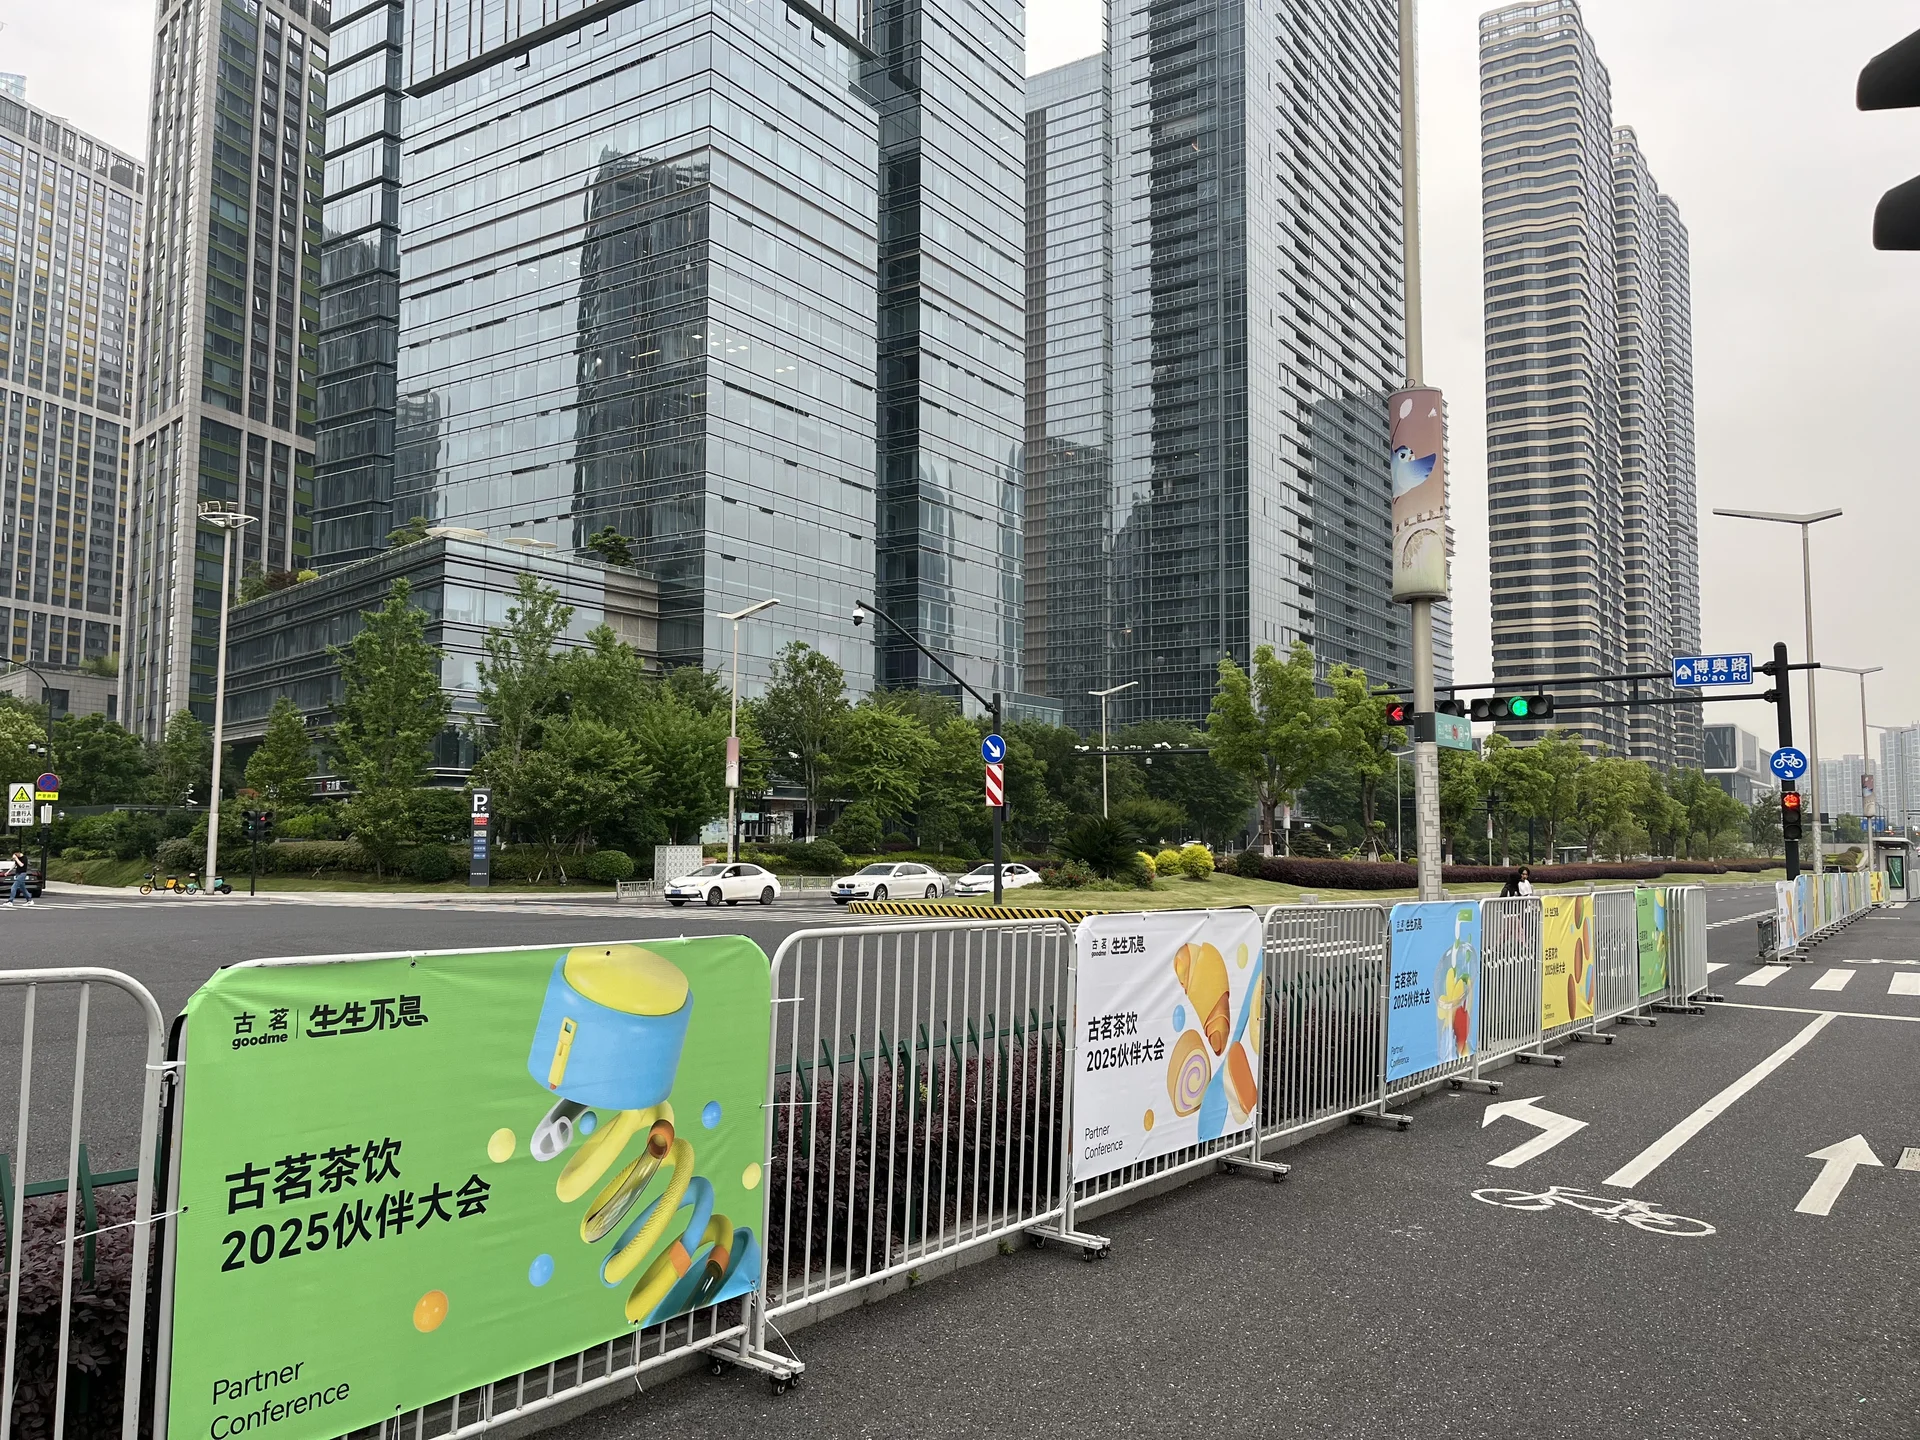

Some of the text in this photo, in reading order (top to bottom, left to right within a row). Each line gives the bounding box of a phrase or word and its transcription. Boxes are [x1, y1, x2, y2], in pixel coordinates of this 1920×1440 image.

[1693, 657, 1748, 674] 博奥路
[1694, 673, 1726, 682] Bo'ao
[1733, 672, 1748, 681] Rd
[473, 794, 488, 812] P
[1092, 935, 1146, 955] 古茗 生生不息
[1394, 970, 1418, 990] 古茗茶饮
[1393, 987, 1431, 1010] 2025伙伴大会
[233, 994, 429, 1039] 古茗 生生不息
[1087, 1012, 1138, 1042] 古茗茶饮
[231, 1032, 289, 1050] goodme
[1086, 1037, 1165, 1072] 2025伙伴大会
[1085, 1124, 1110, 1140] Partner
[1084, 1138, 1123, 1160] Conference
[225, 1138, 402, 1214] 古茗茶饮
[221, 1174, 491, 1273] 2025伙伴大会
[212, 1362, 304, 1405] Partner
[210, 1383, 350, 1440] Conference
